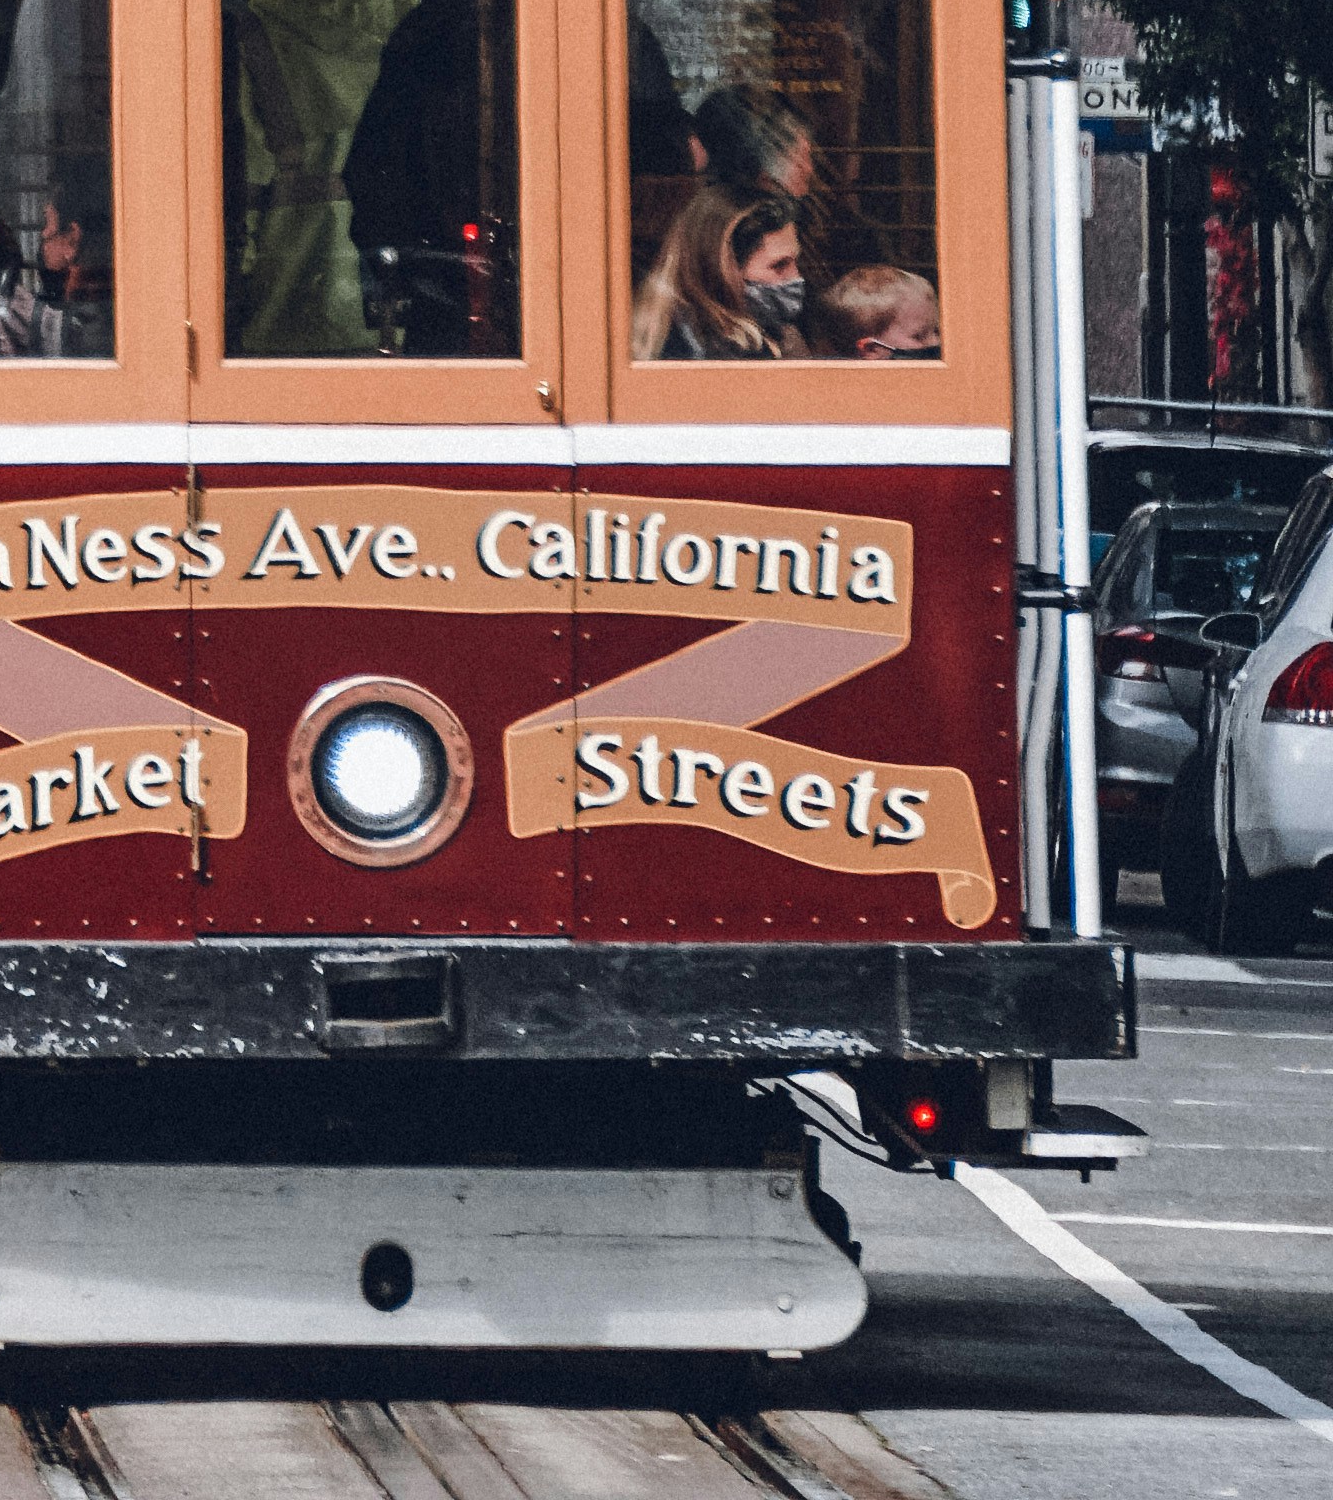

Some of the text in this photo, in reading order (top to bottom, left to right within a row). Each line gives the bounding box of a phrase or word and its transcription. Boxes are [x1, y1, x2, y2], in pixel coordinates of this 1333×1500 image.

[25, 511, 225, 590] Ness
[474, 507, 899, 609] California
[574, 730, 933, 850] Streets
